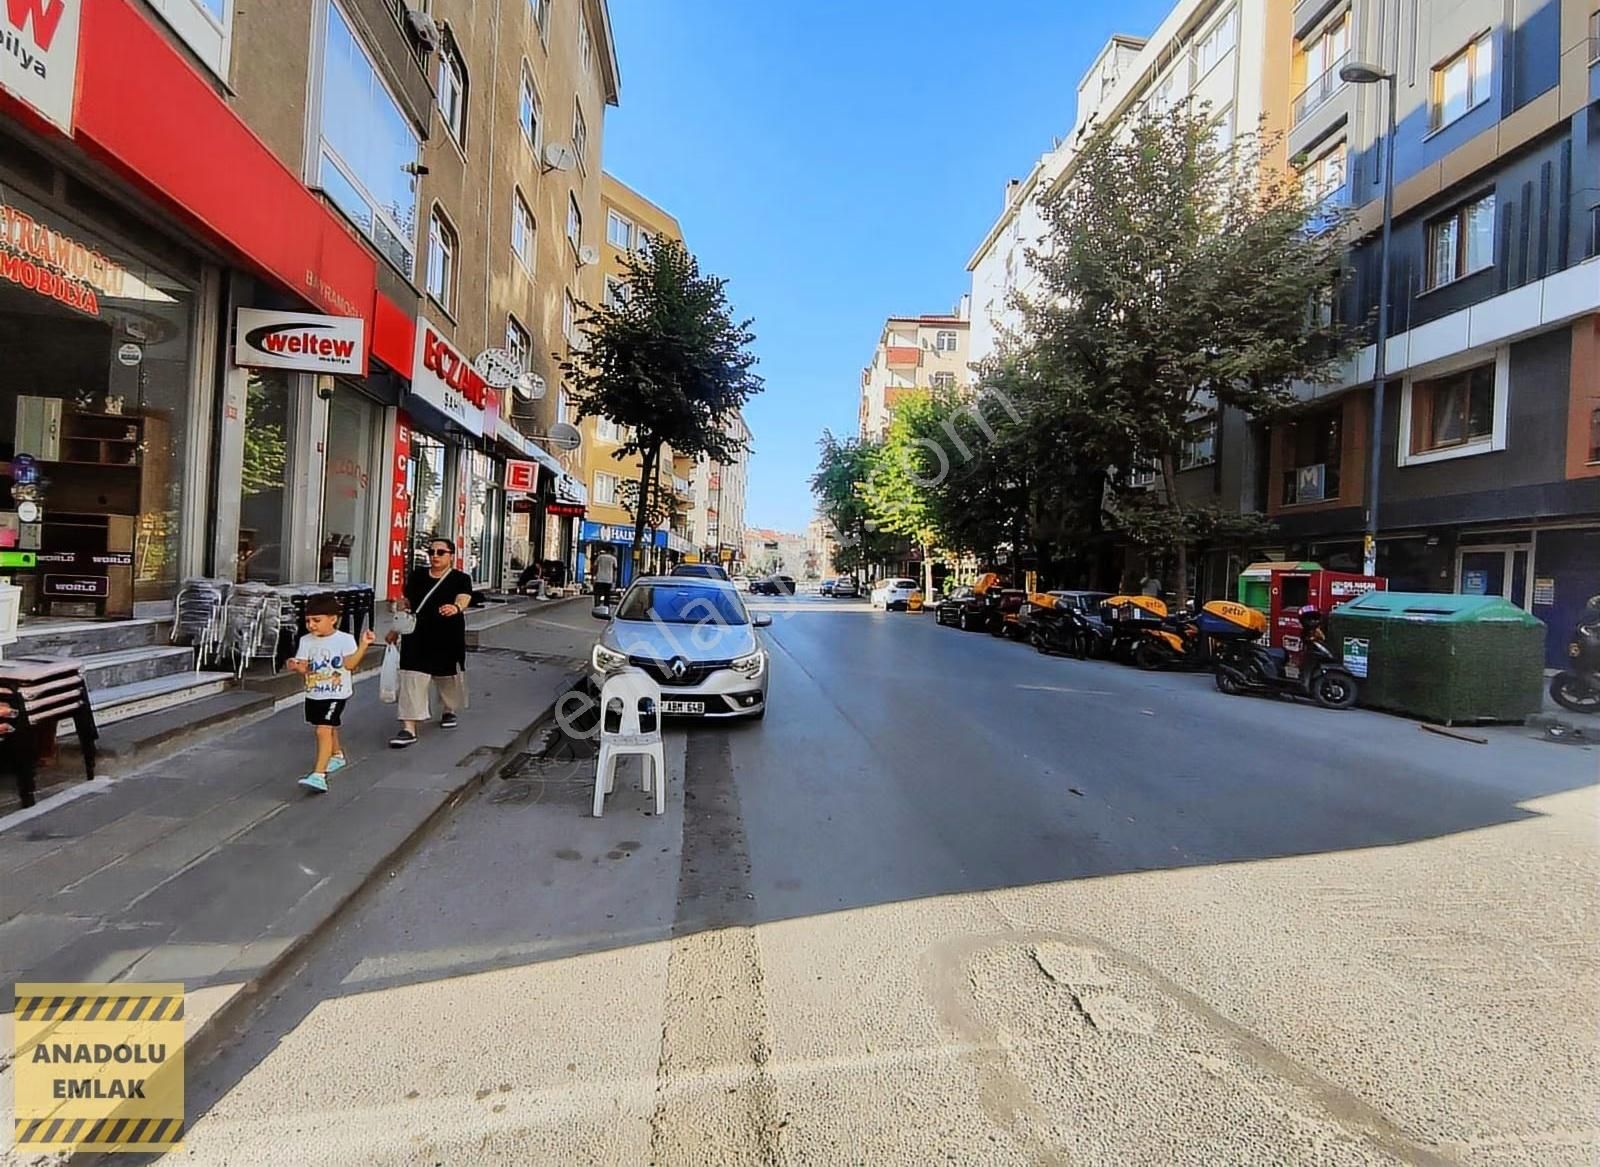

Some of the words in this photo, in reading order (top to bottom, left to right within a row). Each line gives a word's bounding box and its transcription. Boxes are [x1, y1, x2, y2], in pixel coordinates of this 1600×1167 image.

[264, 332, 355, 358] weltew
[511, 465, 531, 487] E
[391, 425, 409, 586] ECZANE
[92, 556, 131, 564] WORLD
[55, 583, 97, 592] WORLD
[1221, 605, 1246, 616] getir
